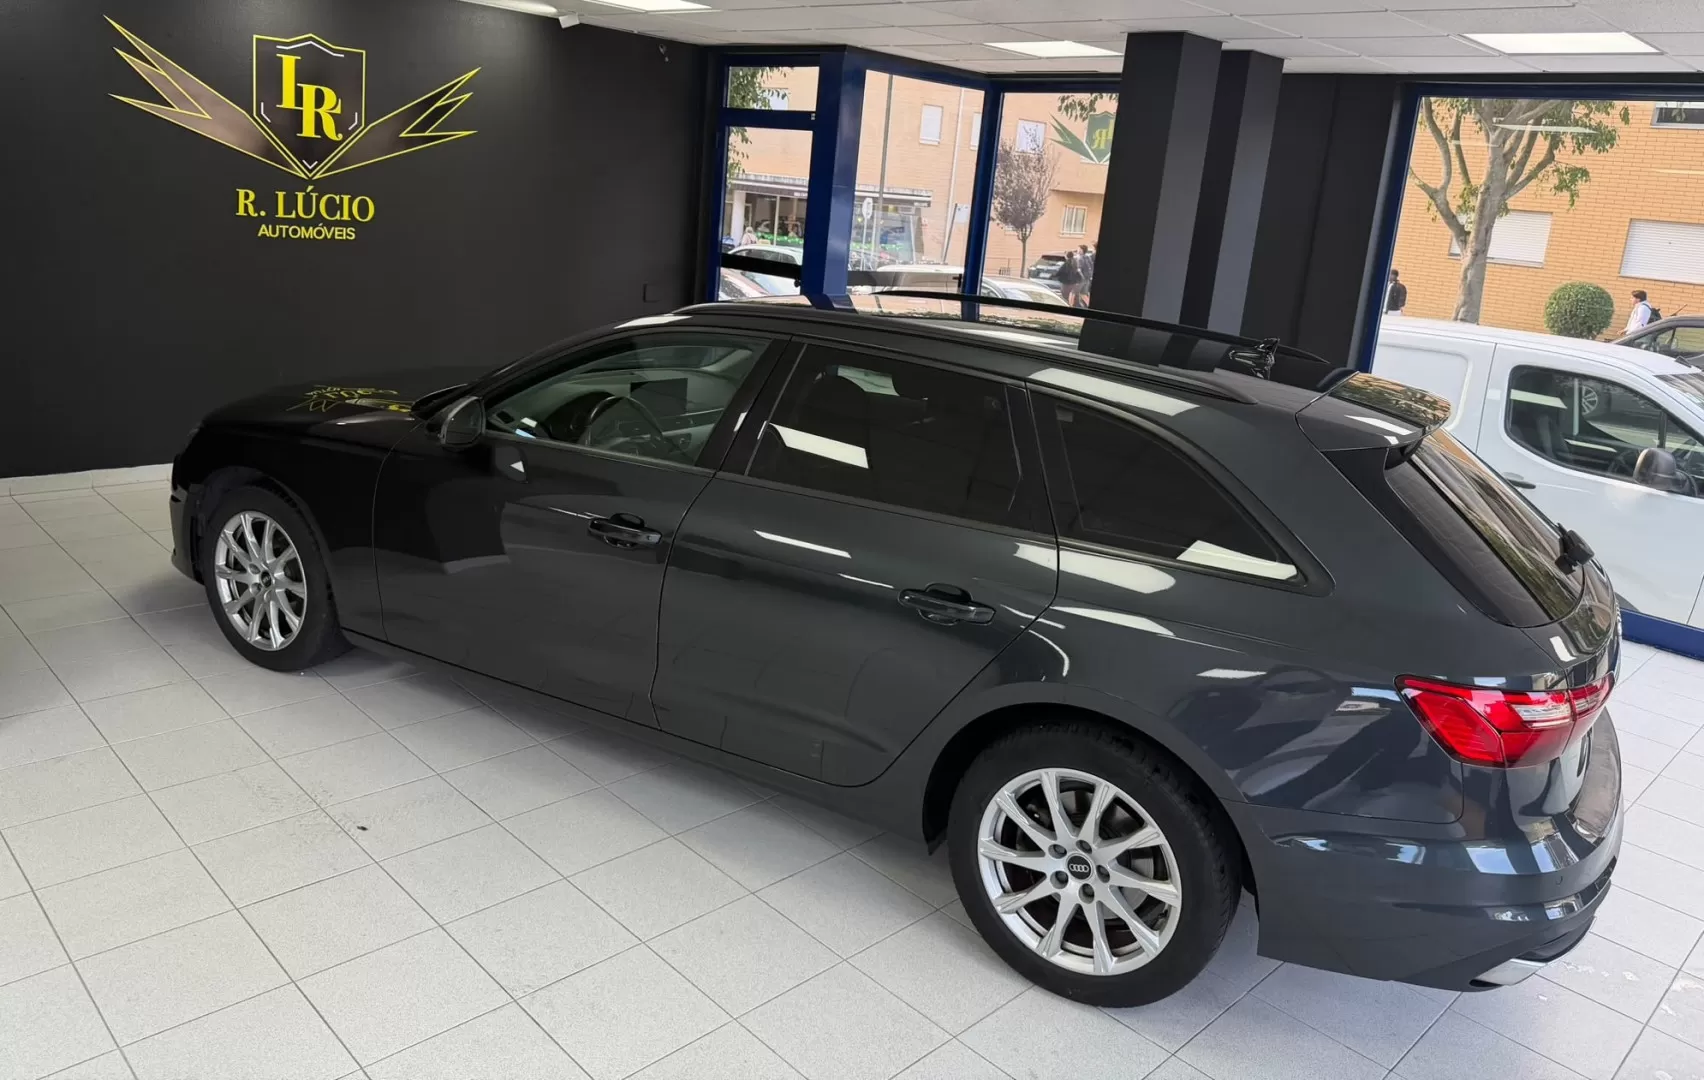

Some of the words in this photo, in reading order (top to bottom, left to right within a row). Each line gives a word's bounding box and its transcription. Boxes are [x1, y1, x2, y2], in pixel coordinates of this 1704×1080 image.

[235, 188, 266, 217] R.
[275, 185, 375, 222] LÚCIO
[257, 223, 356, 240] AUTOMÓVEIS
